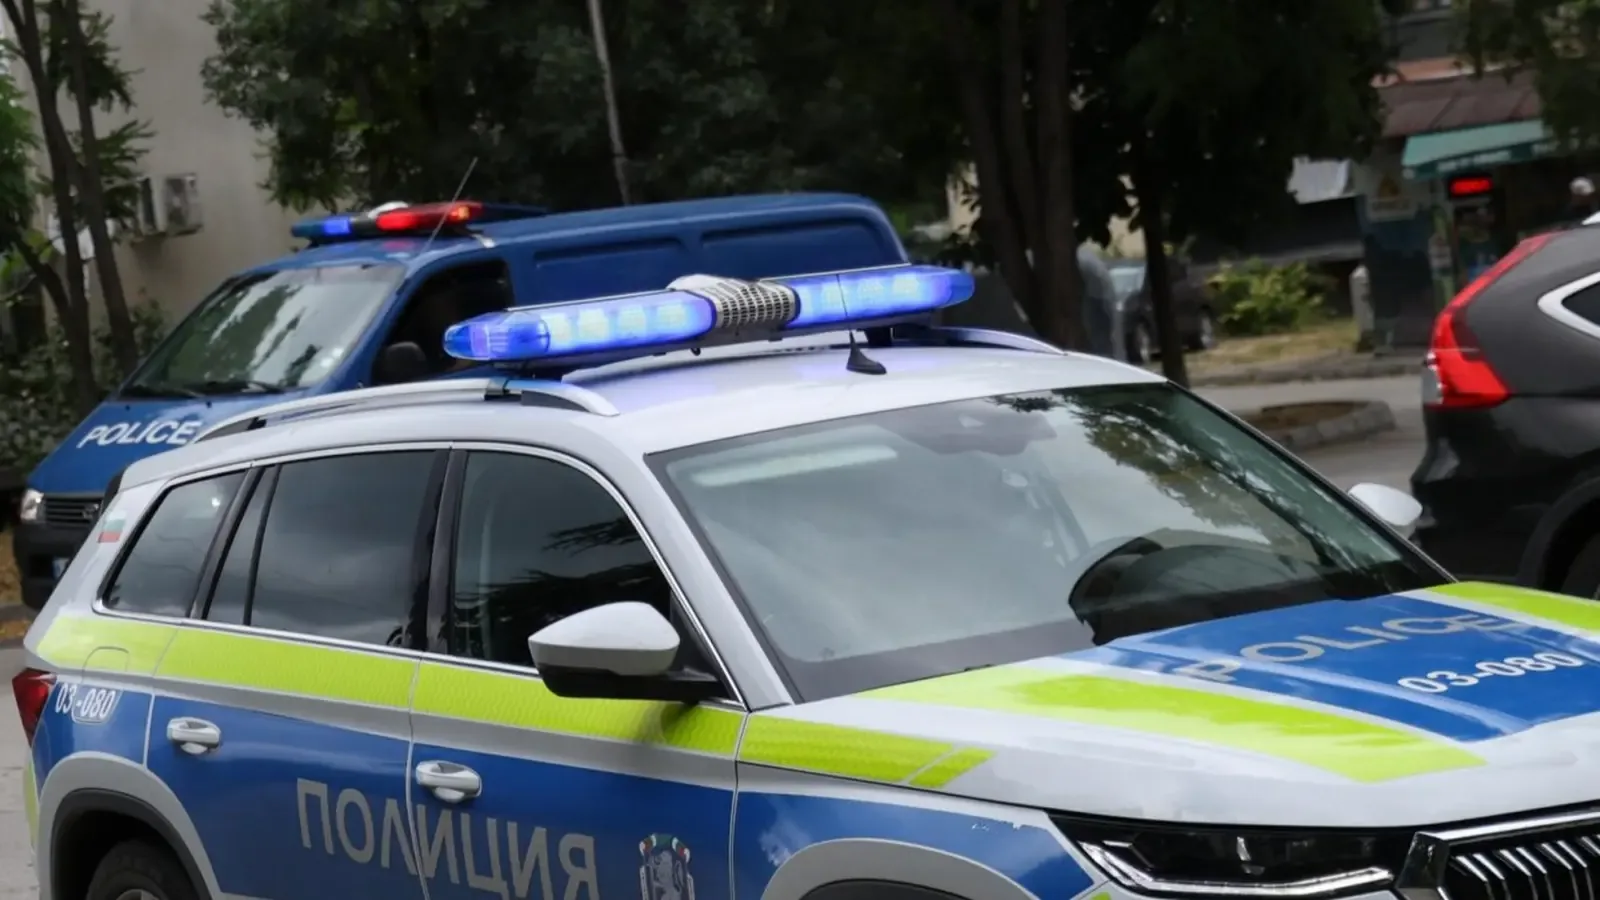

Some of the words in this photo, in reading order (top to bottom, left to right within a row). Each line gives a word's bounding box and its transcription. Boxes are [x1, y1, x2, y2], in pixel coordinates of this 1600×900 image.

[76, 420, 203, 449] POLICE
[1172, 614, 1528, 682] POLICE
[1397, 652, 1585, 693] 03-080
[55, 682, 116, 719] 03-080
[296, 777, 601, 900] ПОЛИЦИЯ
